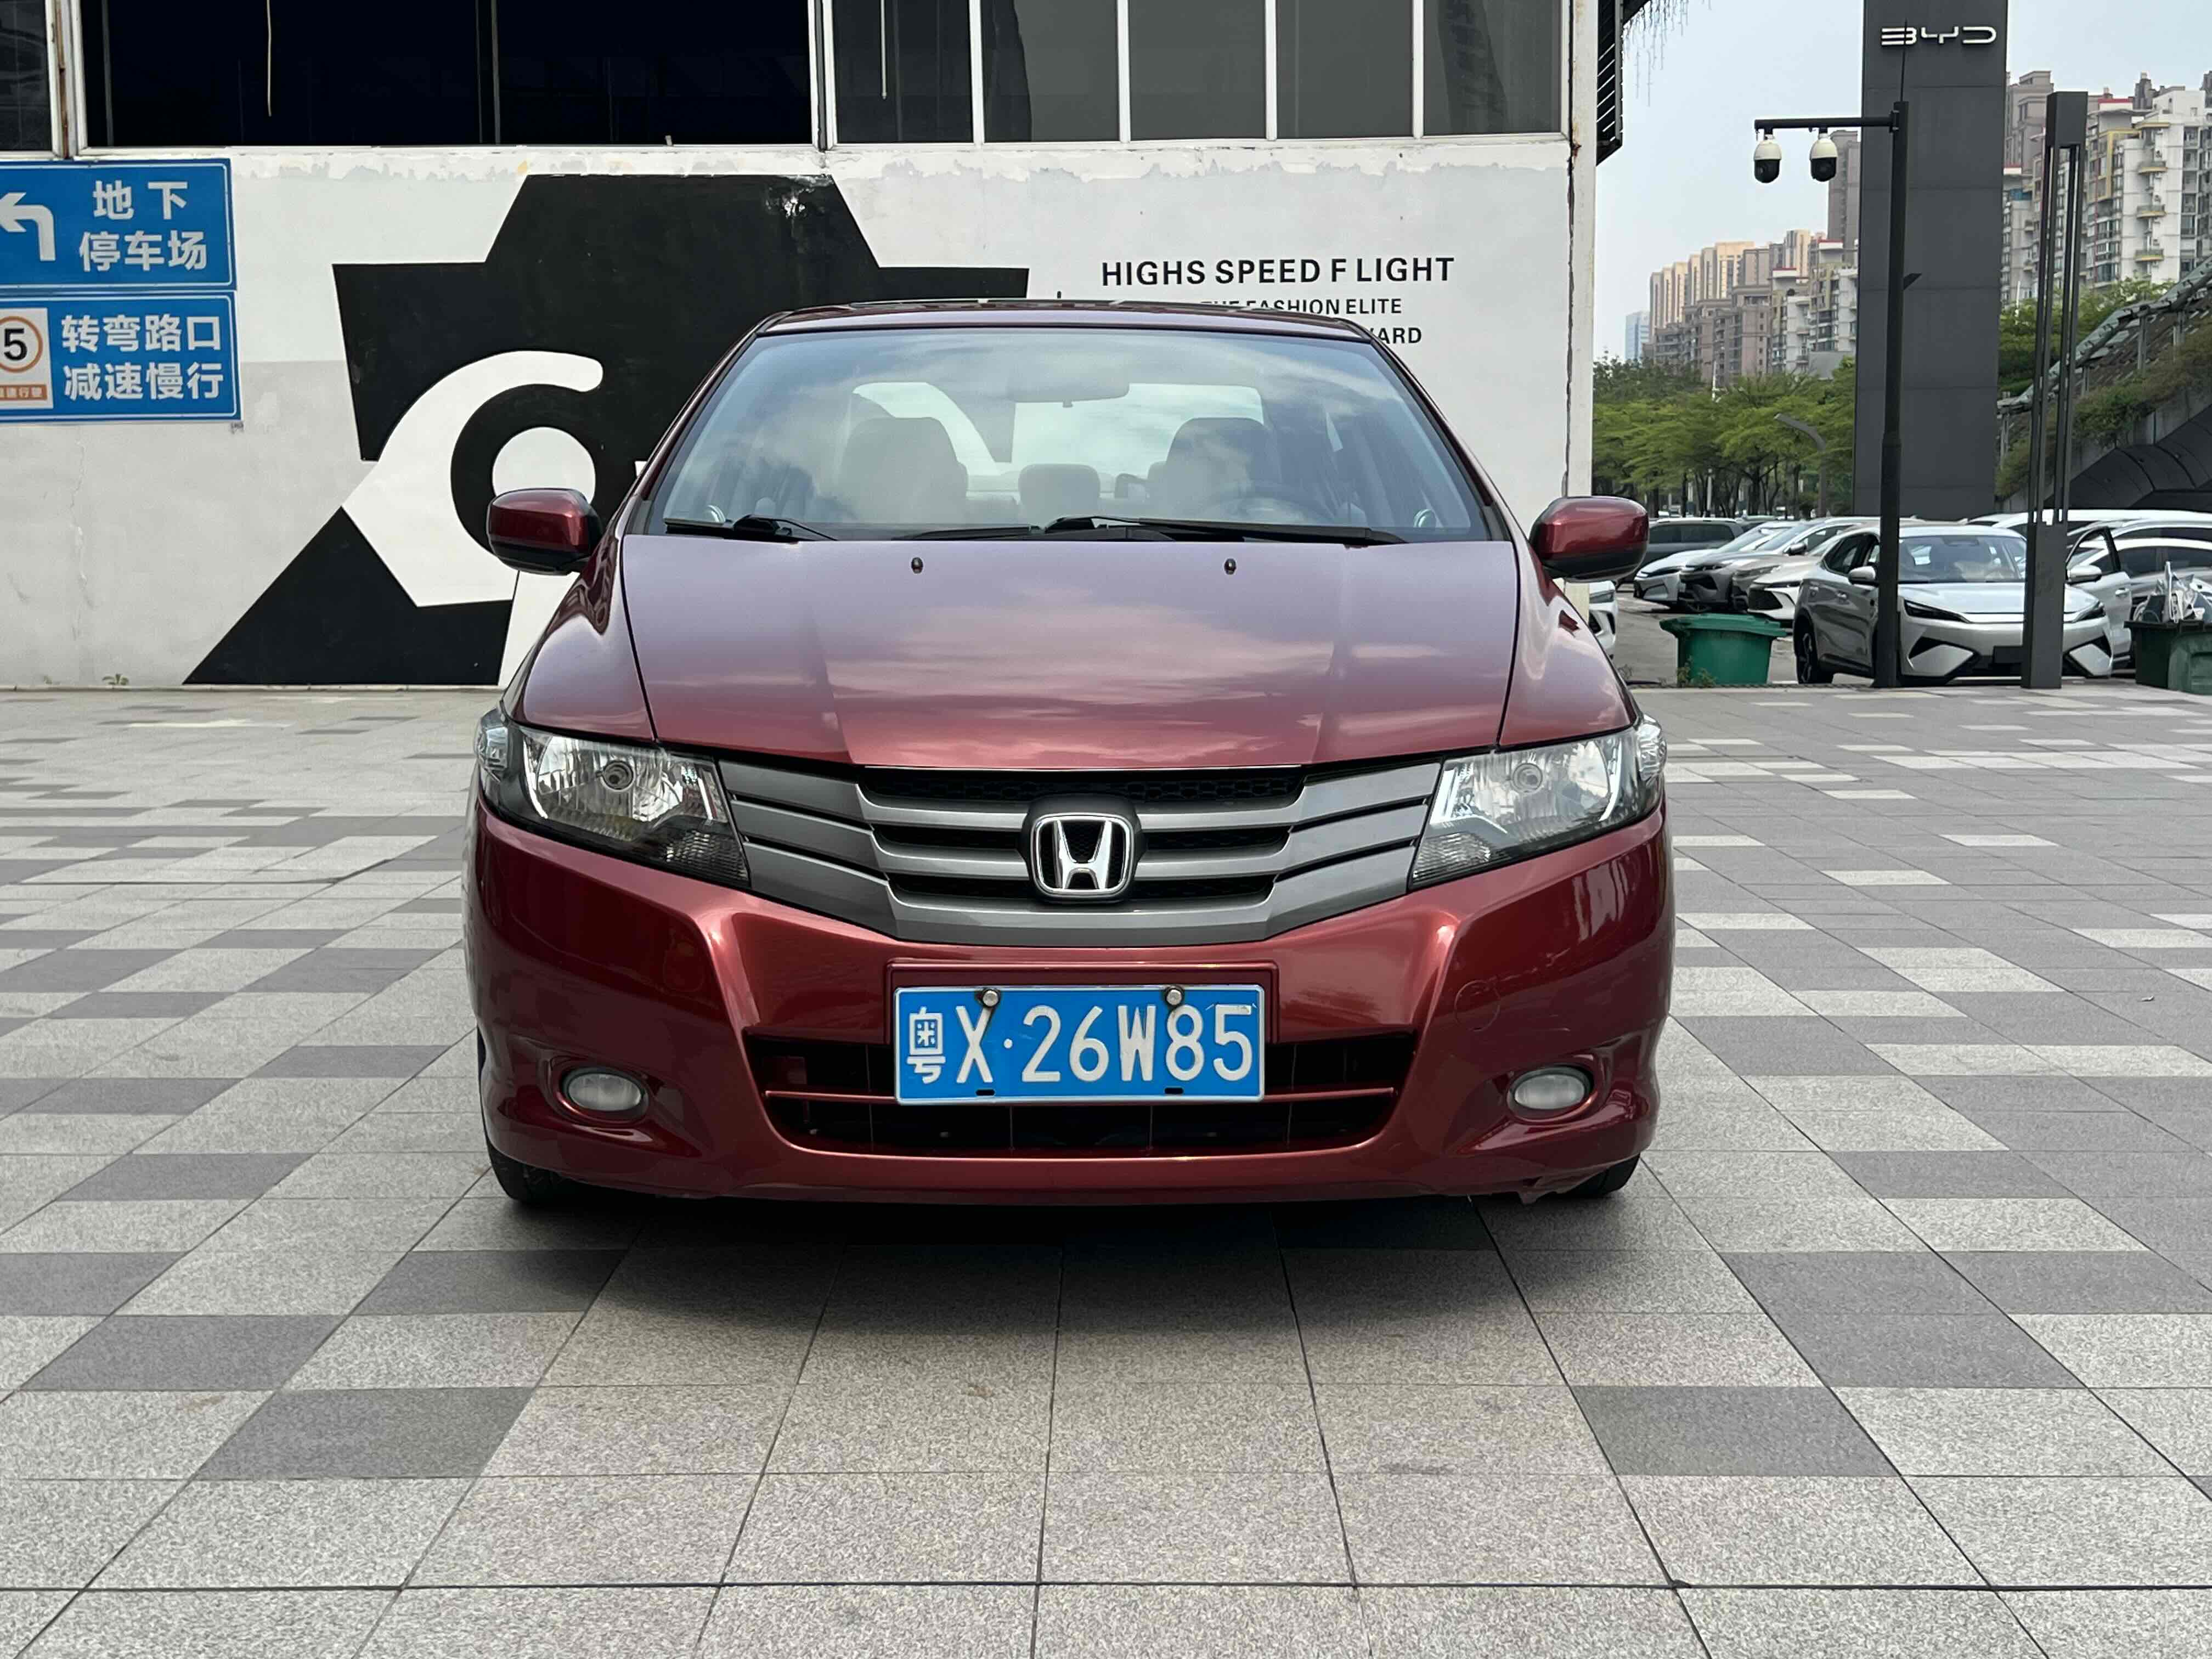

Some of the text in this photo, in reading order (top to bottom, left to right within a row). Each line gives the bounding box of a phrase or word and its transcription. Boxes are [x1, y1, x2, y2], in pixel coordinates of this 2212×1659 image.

[1881, 26, 1997, 46] BYD
[92, 180, 188, 220] 地下
[79, 230, 207, 272] 停车场
[1102, 260, 1206, 286] HIGHS
[1215, 259, 1320, 284] SPEED
[1346, 298, 1402, 314] ELITE
[4, 328, 27, 361] 5
[61, 314, 221, 353] 转弯路口
[1370, 328, 1422, 344] ARD
[63, 362, 224, 400] 减速慢行
